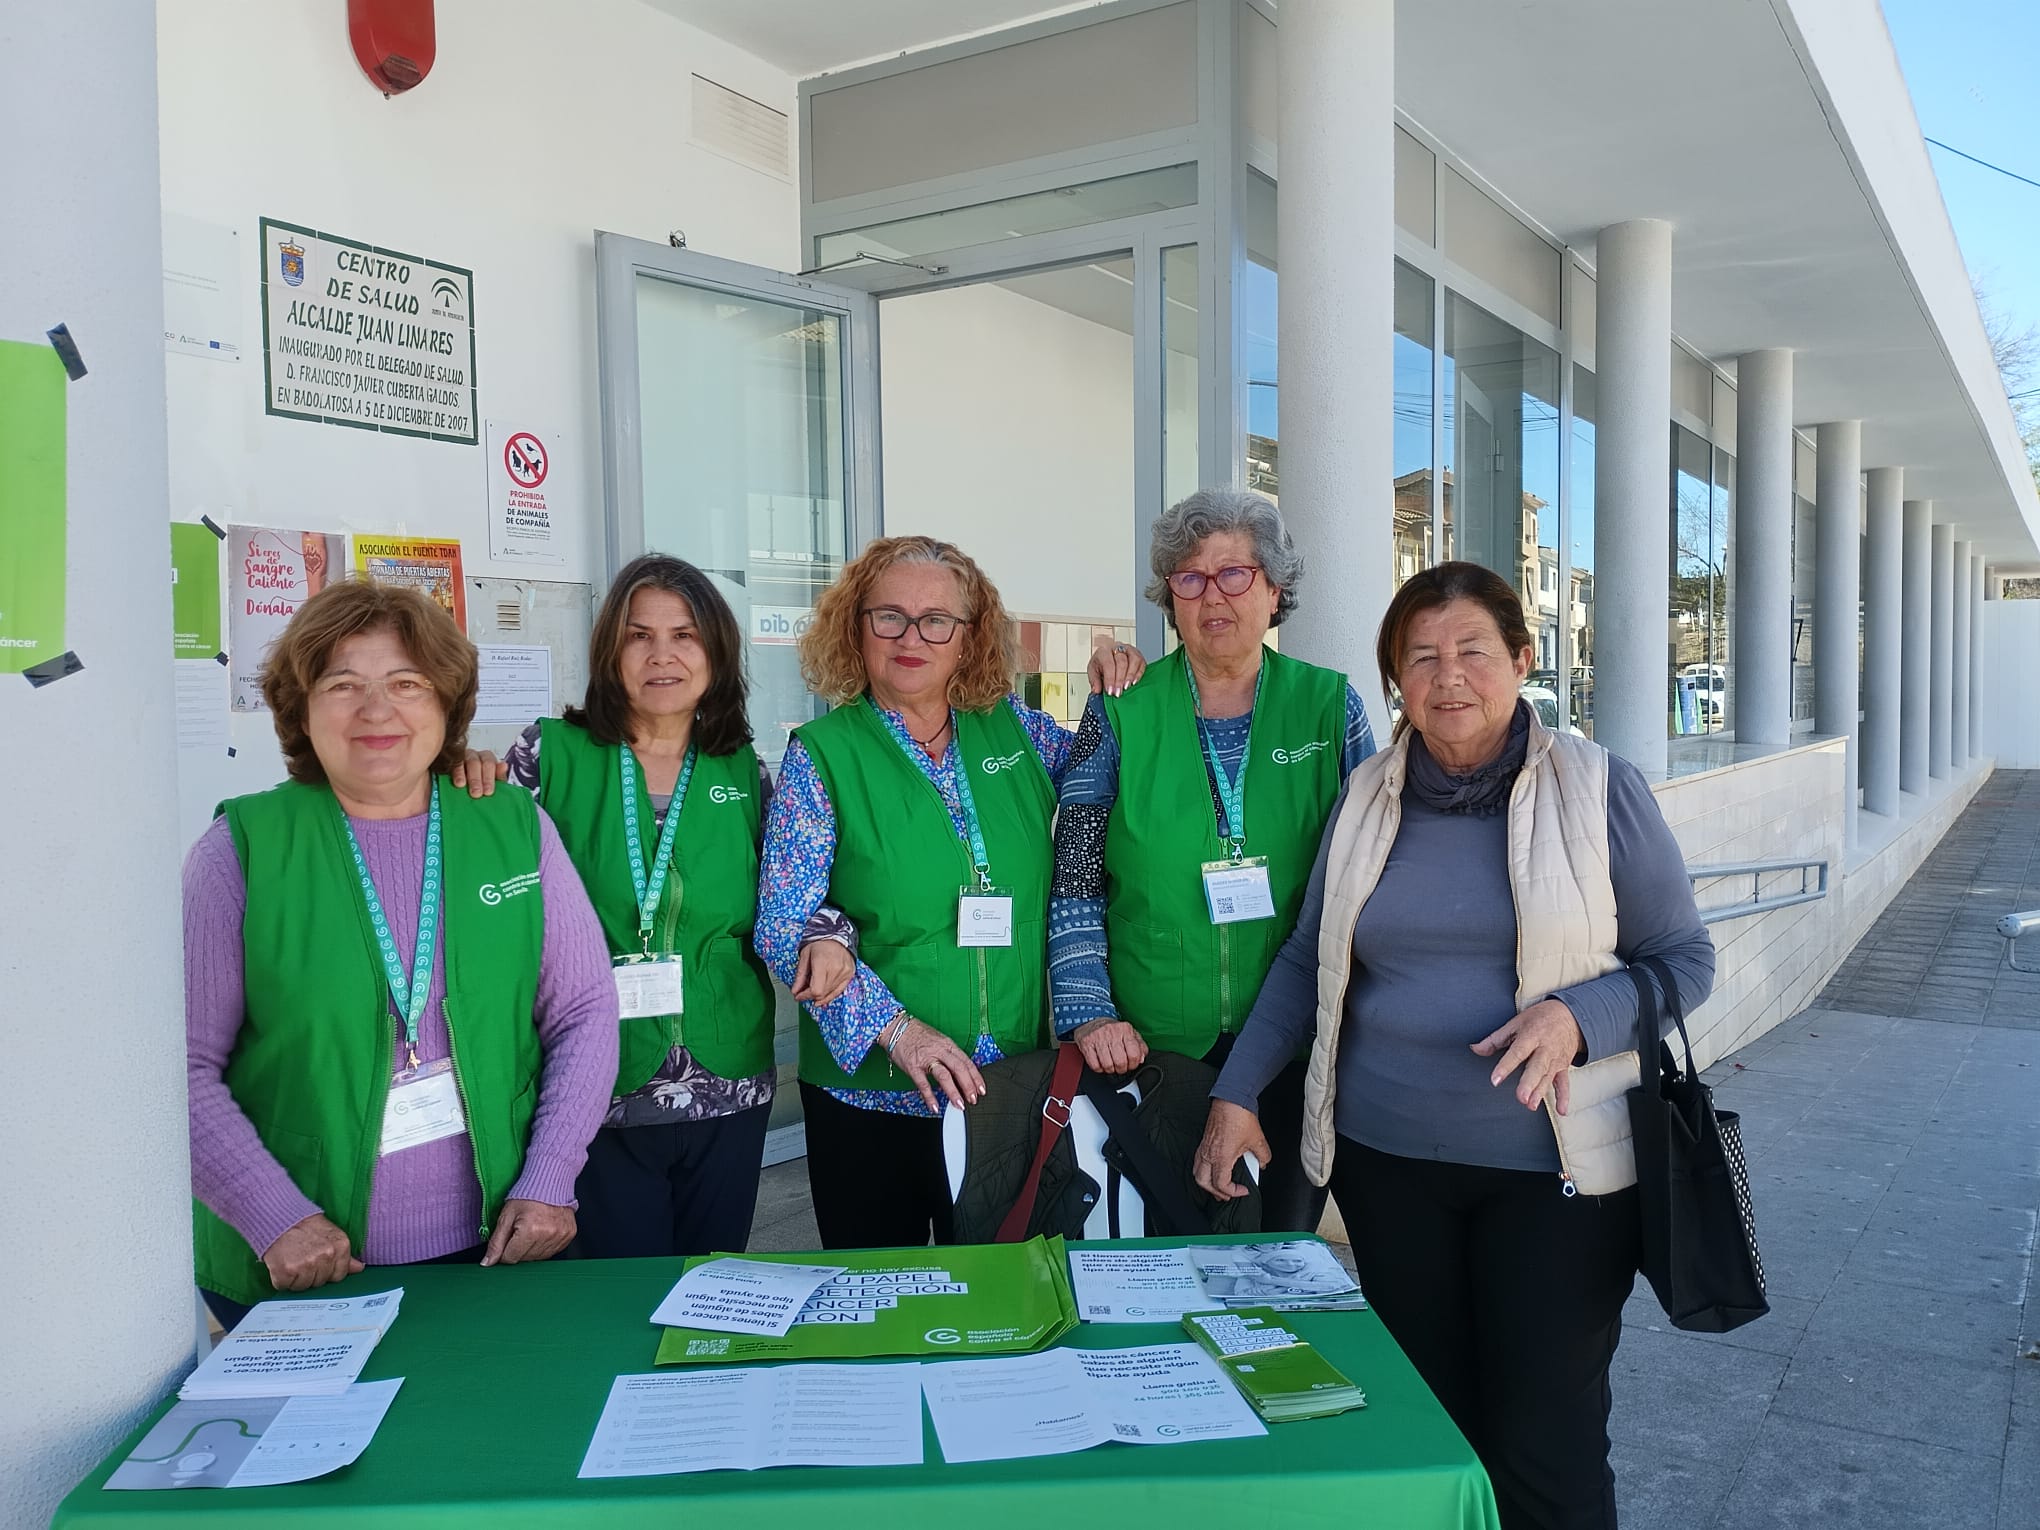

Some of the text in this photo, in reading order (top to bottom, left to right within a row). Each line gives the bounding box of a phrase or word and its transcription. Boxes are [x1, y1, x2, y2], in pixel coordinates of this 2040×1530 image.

[337, 250, 410, 284] CENTRO
[326, 278, 419, 315] DE SALUD
[287, 300, 454, 355] ALCALDE JUAN LINARES
[279, 335, 342, 363] INAUGURADO
[345, 349, 363, 367] POR
[365, 352, 375, 369] EL
[378, 355, 422, 378] DELEGADO
[424, 363, 435, 380] DE
[286, 362, 296, 380] D.
[300, 365, 350, 388] FRANCISCO
[353, 374, 384, 395] JAVIER
[386, 380, 424, 402] CUBERTA
[277, 386, 290, 403] EN
[294, 389, 354, 415] BADOLATOSA
[355, 399, 362, 416] A
[364, 400, 371, 418] 5
[373, 402, 385, 419] DE
[387, 404, 432, 427] DICIEMBRE
[434, 412, 445, 429] DE
[510, 490, 545, 501] PROHIBIDA
[518, 500, 547, 510] ENTRADA
[517, 509, 549, 519] ANIMALES
[516, 518, 550, 528] COMPAÑÍA
[248, 541, 281, 560] Si eres
[360, 543, 401, 556] ASOCIACIÓN
[403, 546, 411, 556] EL
[413, 546, 438, 557] PUENTE
[266, 556, 278, 565] de
[244, 558, 294, 579] Sangre
[371, 565, 450, 577] JORNADA DE PUERTAS ABIERTAS
[247, 575, 294, 589] Caliente
[246, 598, 294, 615] Dónala
[0, 636, 38, 648] áncer
[879, 1266, 898, 1274] hay
[861, 1273, 943, 1285] PAPEL
[720, 1288, 754, 1298] ayuda
[685, 1292, 789, 1311] que necesite algún
[772, 1296, 794, 1304] tipo
[691, 1302, 784, 1319] sabes de alguien
[694, 1311, 729, 1321] cáncer
[731, 1316, 766, 1326] tienes
[967, 1327, 1020, 1335] asociación
[1130, 1350, 1170, 1358] cáncer
[1136, 1355, 1182, 1364] alguien
[284, 1363, 324, 1372] tienes
[1110, 1363, 1162, 1372] necesite
[1164, 1360, 1199, 1369] algún
[1133, 1369, 1171, 1378] ayuda
[1176, 1380, 1205, 1388] gratis
